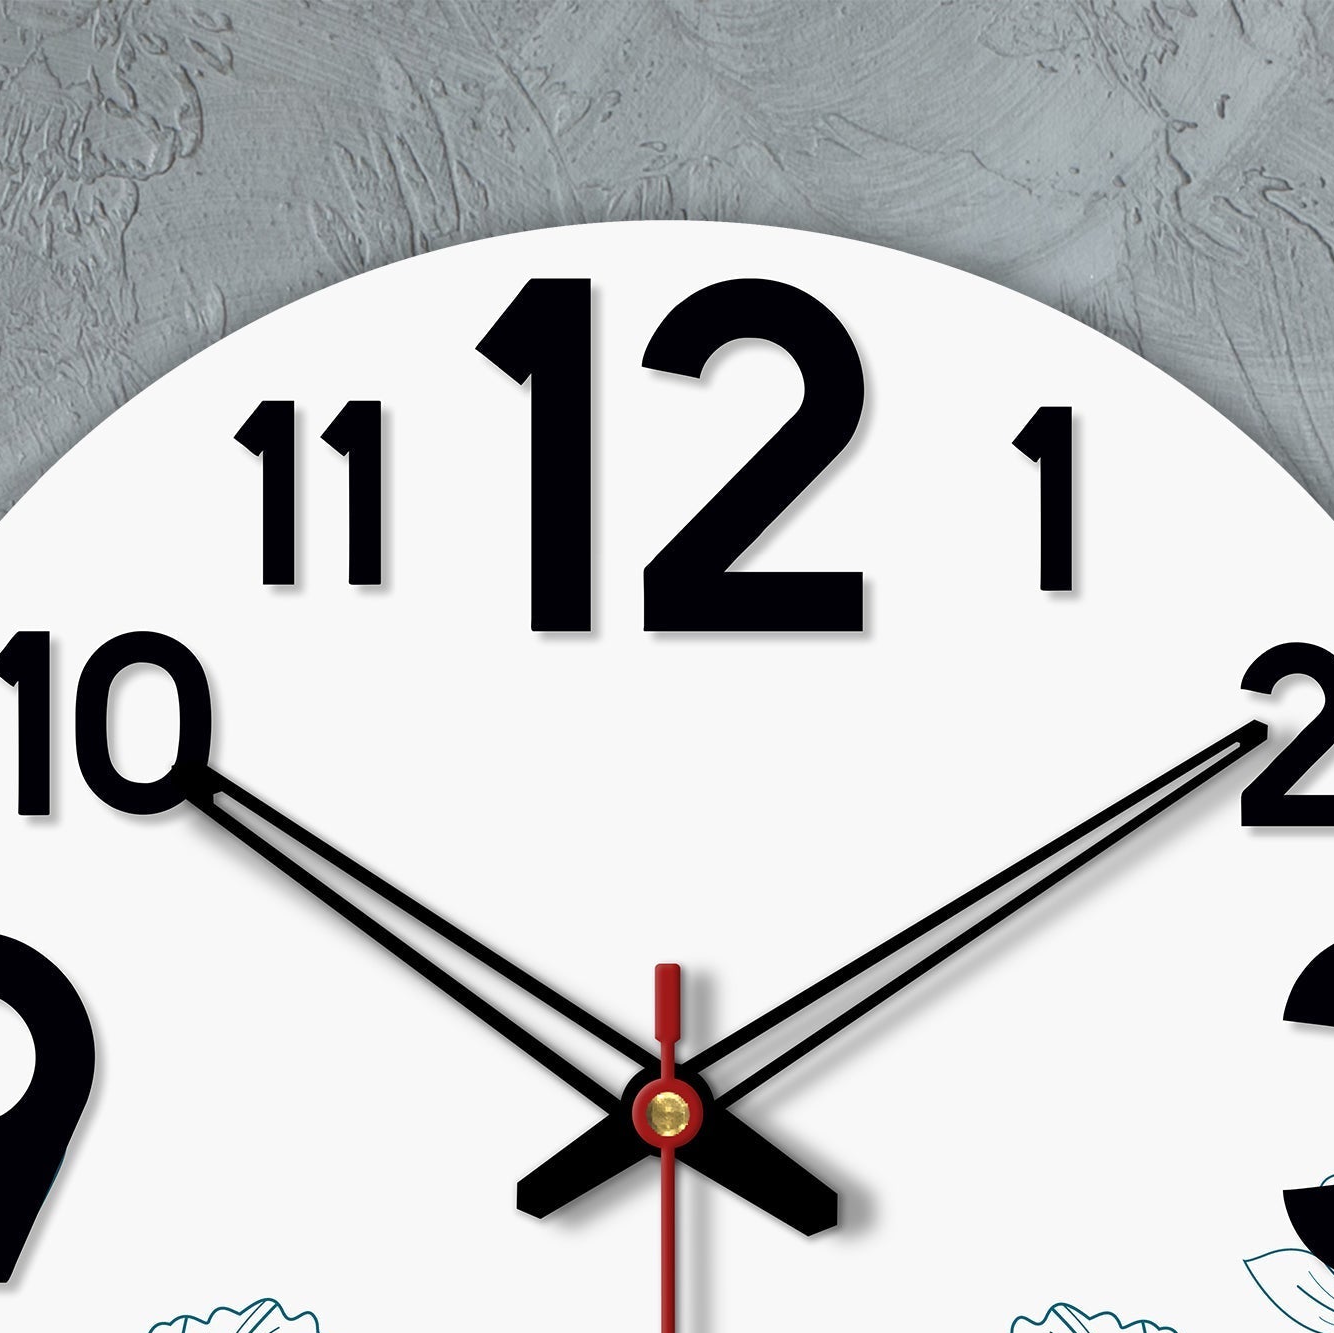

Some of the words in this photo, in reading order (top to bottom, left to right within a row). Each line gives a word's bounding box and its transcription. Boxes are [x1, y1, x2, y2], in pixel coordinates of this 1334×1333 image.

[234, 401, 382, 586] 11
[475, 279, 865, 632] 12
[1012, 407, 1073, 592] 1
